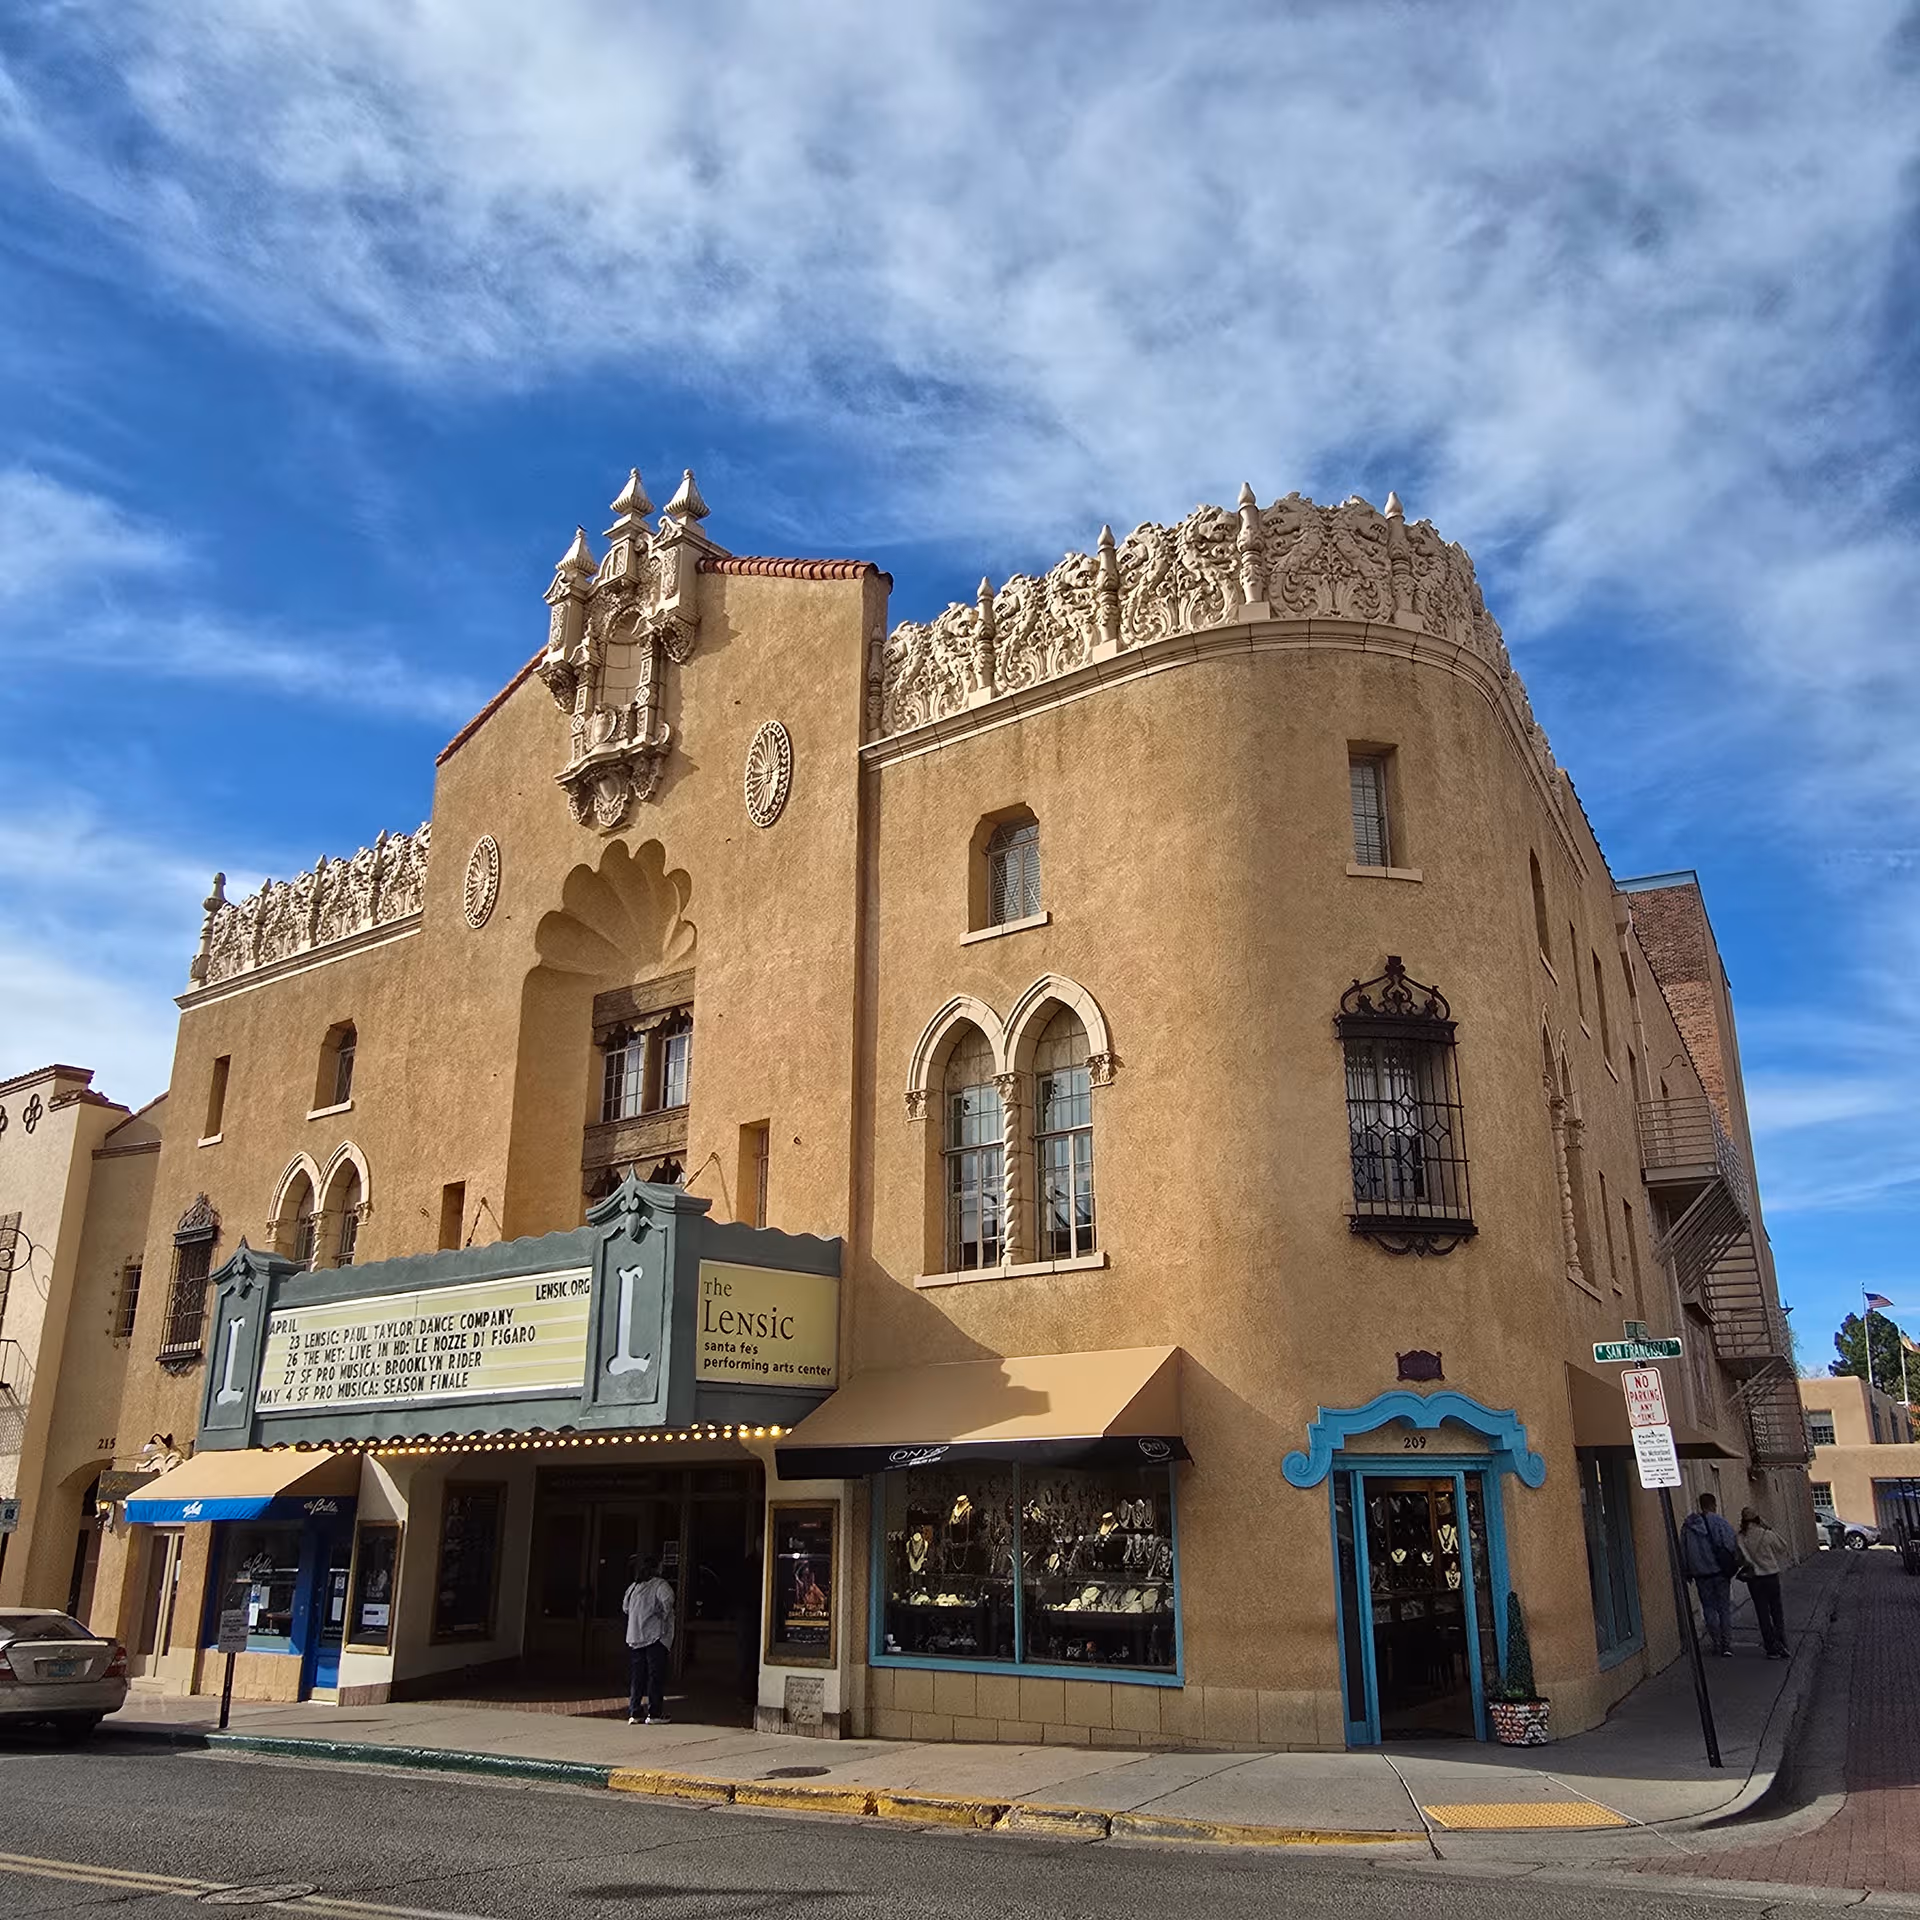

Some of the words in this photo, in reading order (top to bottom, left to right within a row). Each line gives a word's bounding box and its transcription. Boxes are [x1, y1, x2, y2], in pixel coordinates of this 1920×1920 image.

[536, 1277, 591, 1301] LENSIC.ORG
[704, 1277, 732, 1297] The
[269, 1318, 298, 1335] APRIL
[289, 1335, 300, 1350] 23
[305, 1330, 339, 1348] LENSIC:
[344, 1326, 367, 1344] PAUL
[374, 1320, 413, 1340] TAYLOR
[420, 1315, 454, 1335] DANCE
[460, 1308, 514, 1330] COMPANY
[286, 1353, 298, 1367] 26
[304, 1350, 320, 1366] THE
[325, 1347, 345, 1363] MET:
[349, 1344, 371, 1361] LIVE
[378, 1342, 388, 1357] IN
[393, 1340, 409, 1355] HD:
[415, 1337, 427, 1354] LE
[434, 1333, 467, 1352] NOZZE
[473, 1332, 485, 1348] DI
[492, 1325, 536, 1346] FIGARO
[704, 1341, 736, 1353] santa
[740, 1342, 758, 1355] fe's
[1605, 1344, 1622, 1360] SAN
[1624, 1340, 1669, 1359] FRANCISCO
[284, 1370, 296, 1385] 27
[301, 1368, 312, 1384] SF
[316, 1366, 335, 1382] PRO
[340, 1361, 380, 1379] MUSICA:
[385, 1353, 443, 1375] BROOKLYN
[448, 1351, 482, 1370] RIDER
[703, 1357, 769, 1374] performing
[773, 1361, 794, 1374] arts
[798, 1364, 832, 1376] center
[260, 1389, 280, 1404] MAY
[286, 1388, 292, 1402] 4
[297, 1387, 309, 1402] SF
[313, 1384, 333, 1400] PRO
[338, 1380, 379, 1398] MUSICA:
[384, 1376, 425, 1395] SEASON
[430, 1372, 468, 1390] FINALE
[1634, 1375, 1649, 1389] NO
[1629, 1389, 1660, 1403] PARKING
[1640, 1403, 1653, 1411] ANY
[97, 1438, 116, 1449] 215
[1404, 1436, 1426, 1449] 209
